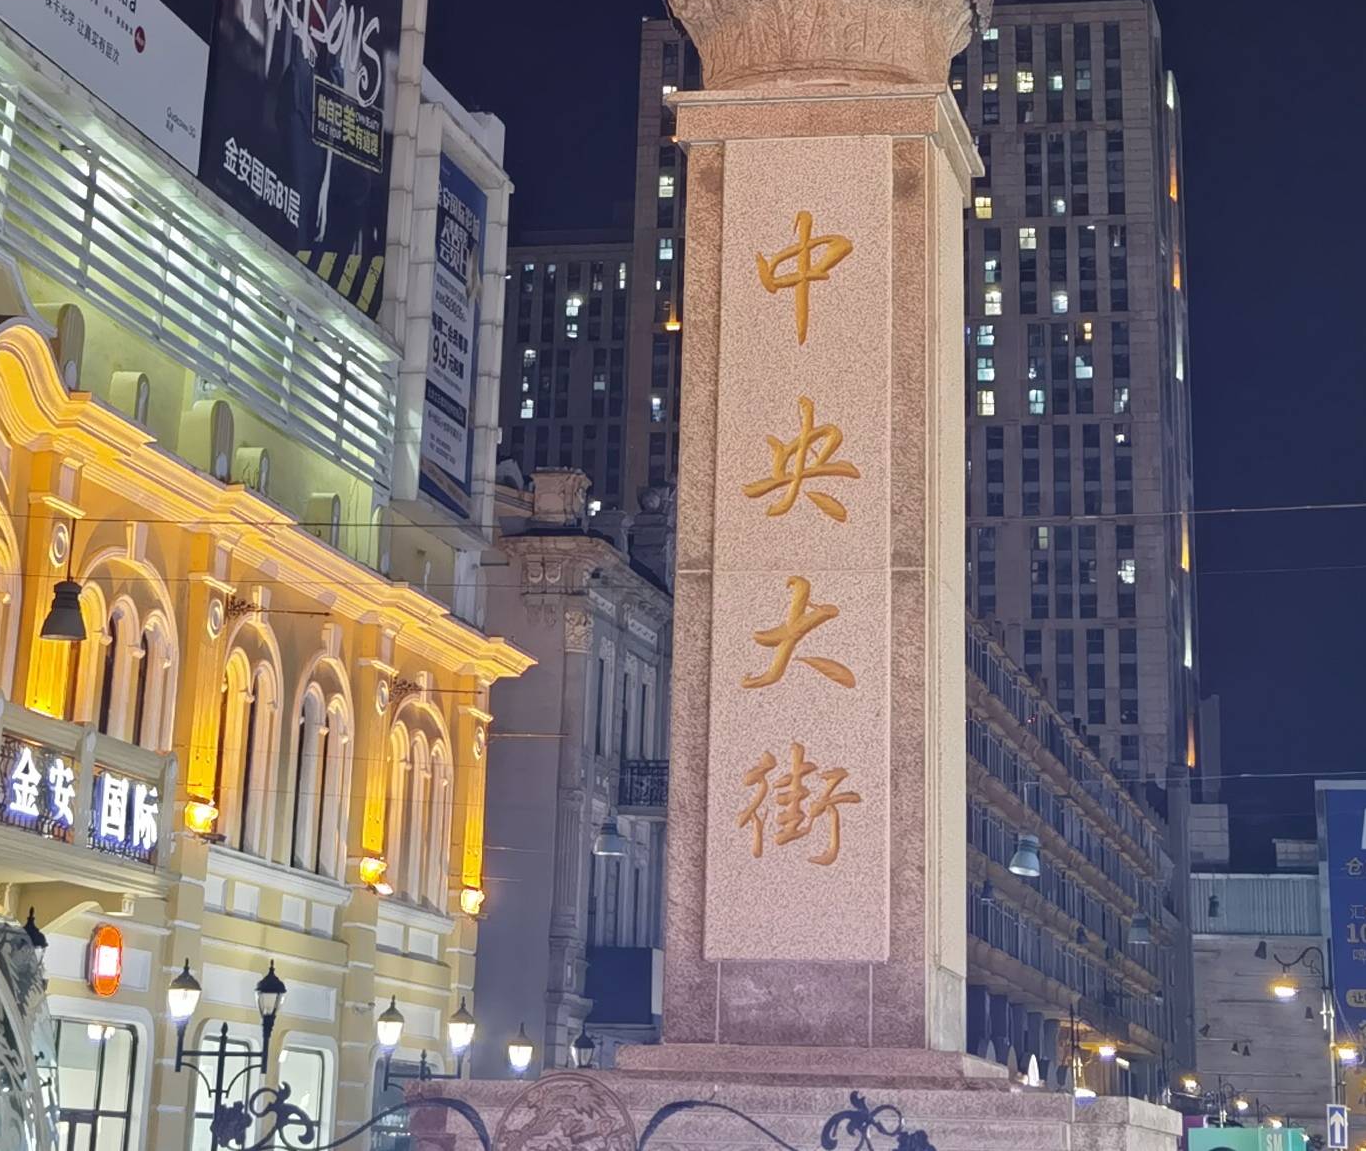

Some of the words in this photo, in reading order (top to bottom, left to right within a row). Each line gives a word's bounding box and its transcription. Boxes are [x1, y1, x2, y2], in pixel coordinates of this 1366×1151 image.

[223, 137, 300, 229] 金安国际B1层
[736, 209, 863, 866] 中央大街
[8, 747, 159, 850] 金安国际
